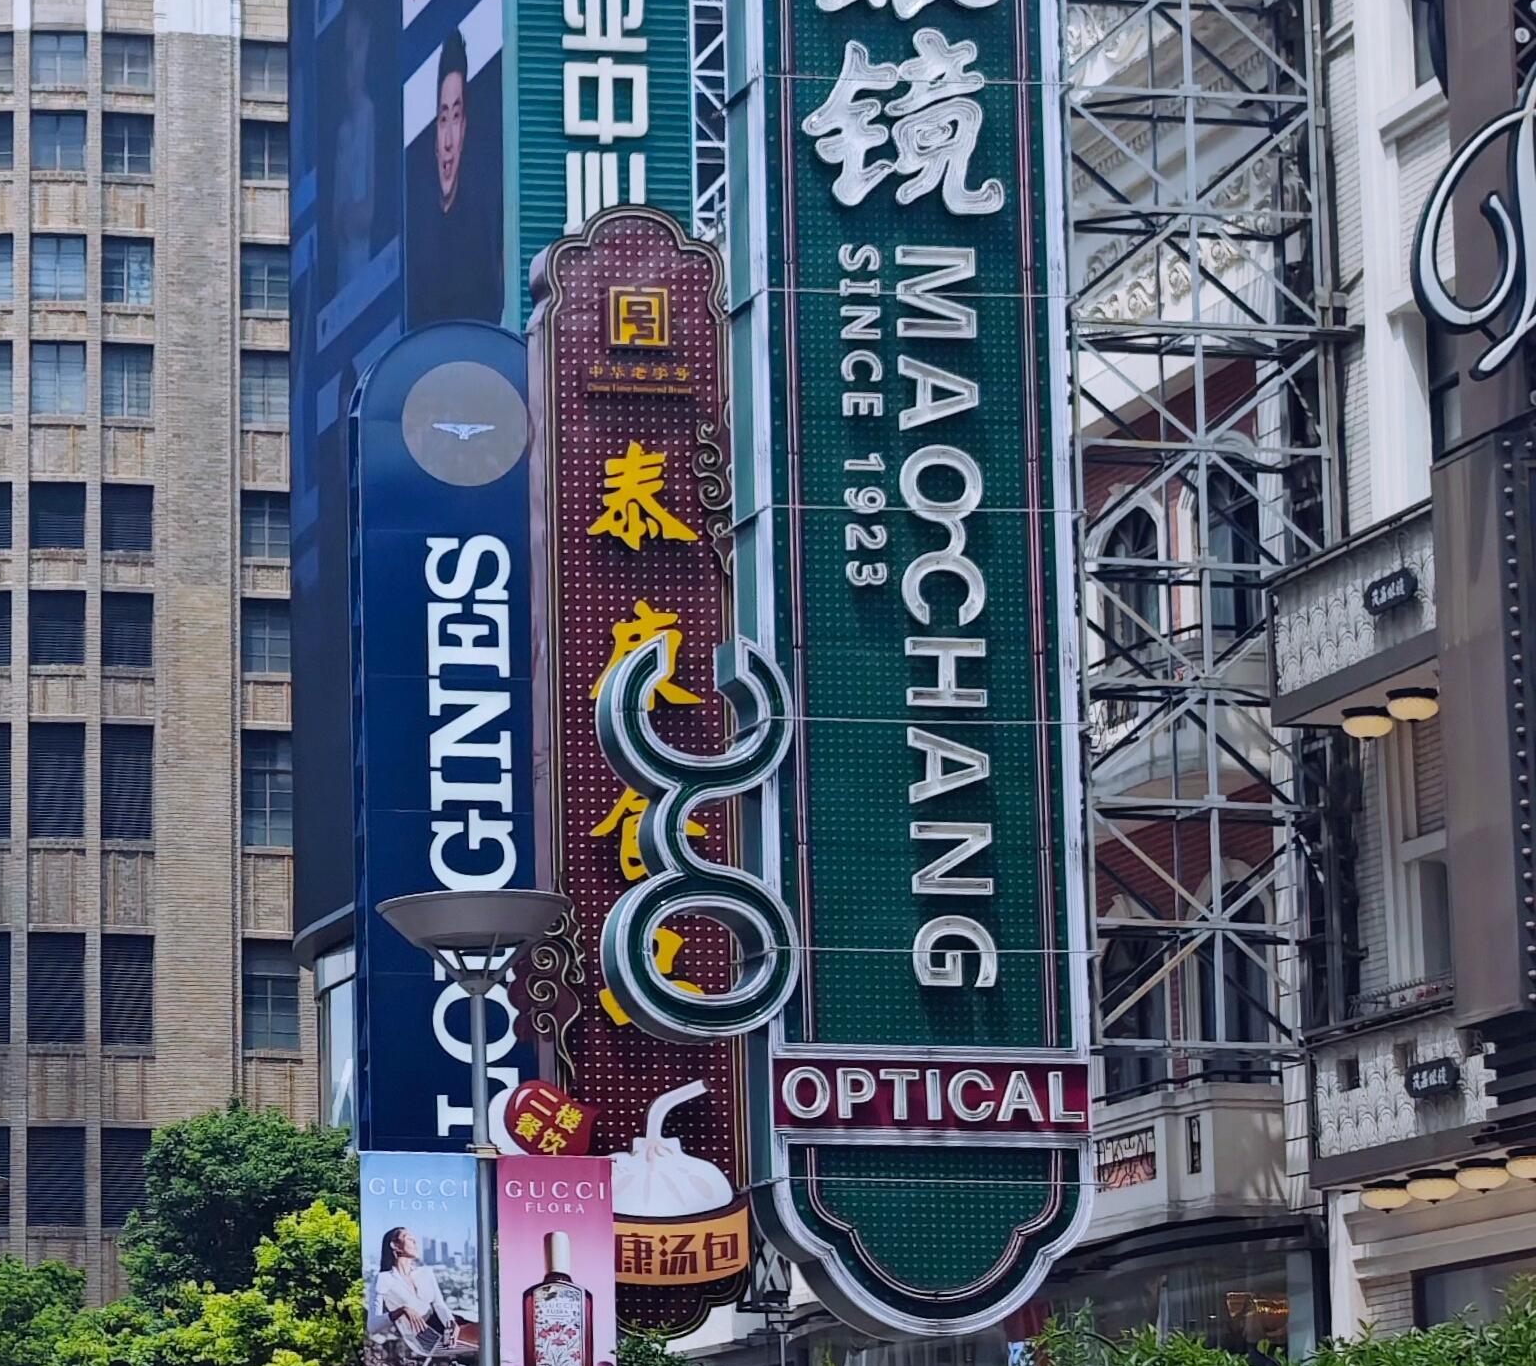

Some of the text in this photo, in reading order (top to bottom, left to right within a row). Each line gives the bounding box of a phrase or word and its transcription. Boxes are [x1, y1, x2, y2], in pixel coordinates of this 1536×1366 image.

[838, 244, 889, 588] SINCE 1923
[895, 246, 998, 989] MAOCHANG
[425, 534, 519, 1137] LOGINES
[529, 1087, 583, 1134] 二楼
[781, 1067, 1086, 1125] OPTICAL
[368, 1177, 468, 1197] GUCCI
[388, 1199, 448, 1212] FLORA
[504, 1180, 605, 1200] GUCCI
[525, 1202, 585, 1215] FLORA
